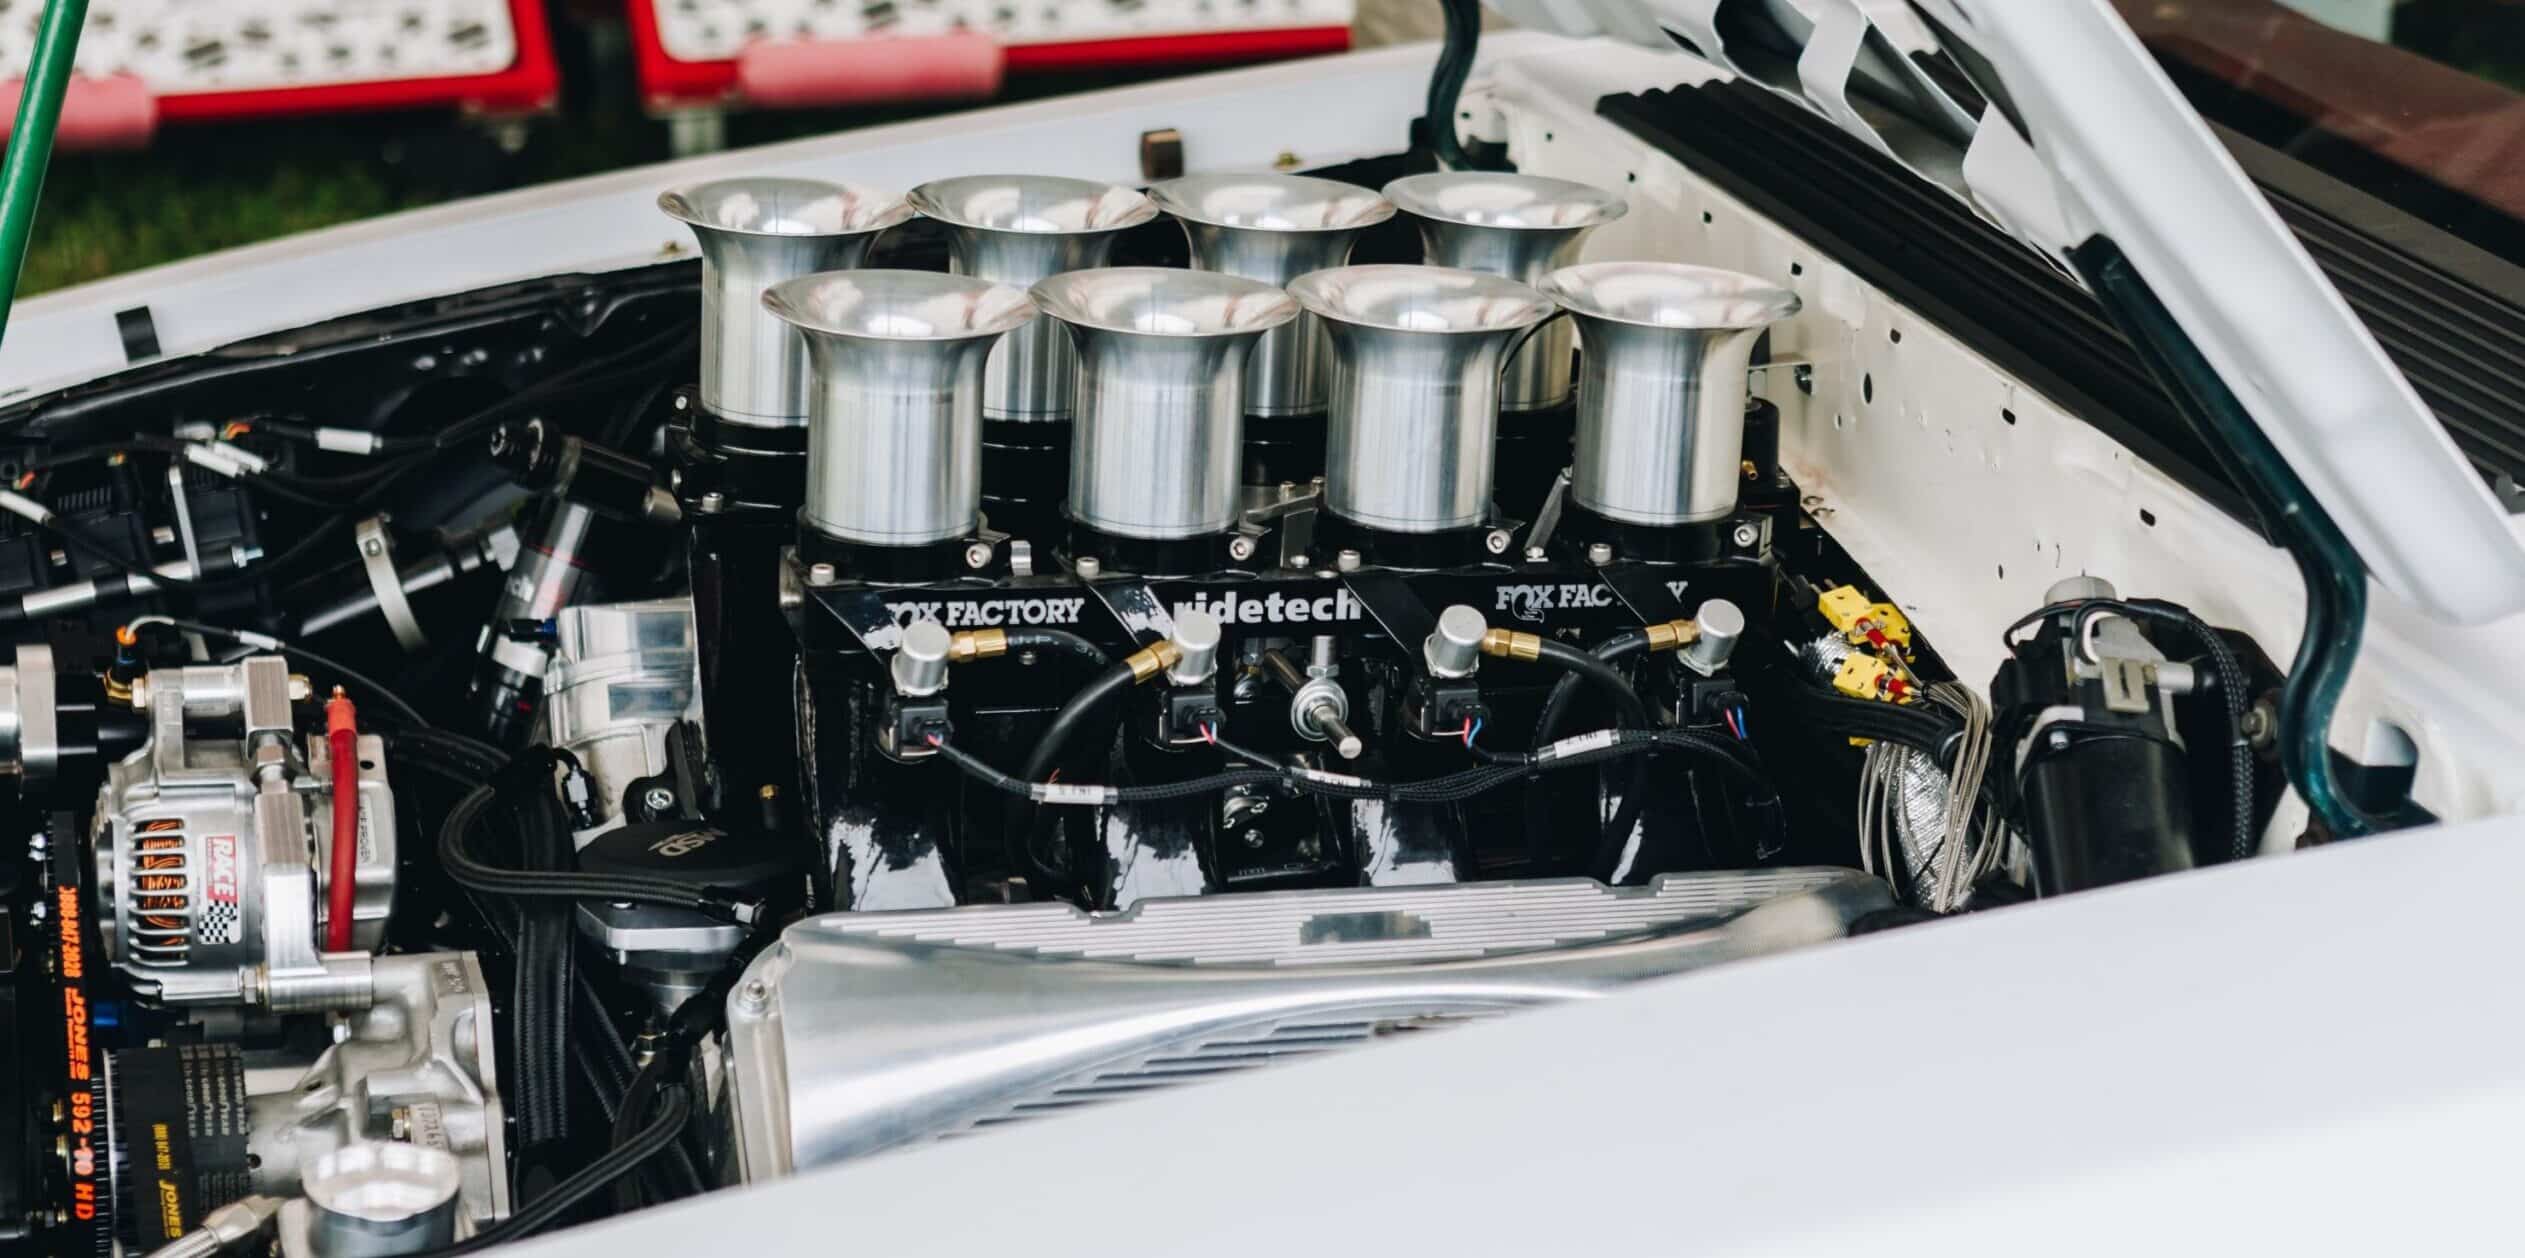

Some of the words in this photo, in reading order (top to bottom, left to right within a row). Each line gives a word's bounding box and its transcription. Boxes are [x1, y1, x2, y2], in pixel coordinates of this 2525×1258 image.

[946, 598, 1085, 626] FACTORY
[1173, 588, 1361, 625] ridetech
[1496, 584, 1554, 620] FOX
[1558, 581, 1688, 608] FACY
[213, 839, 235, 896] RACE
[72, 987, 91, 1080] JONES
[159, 1179, 182, 1238] JONES
